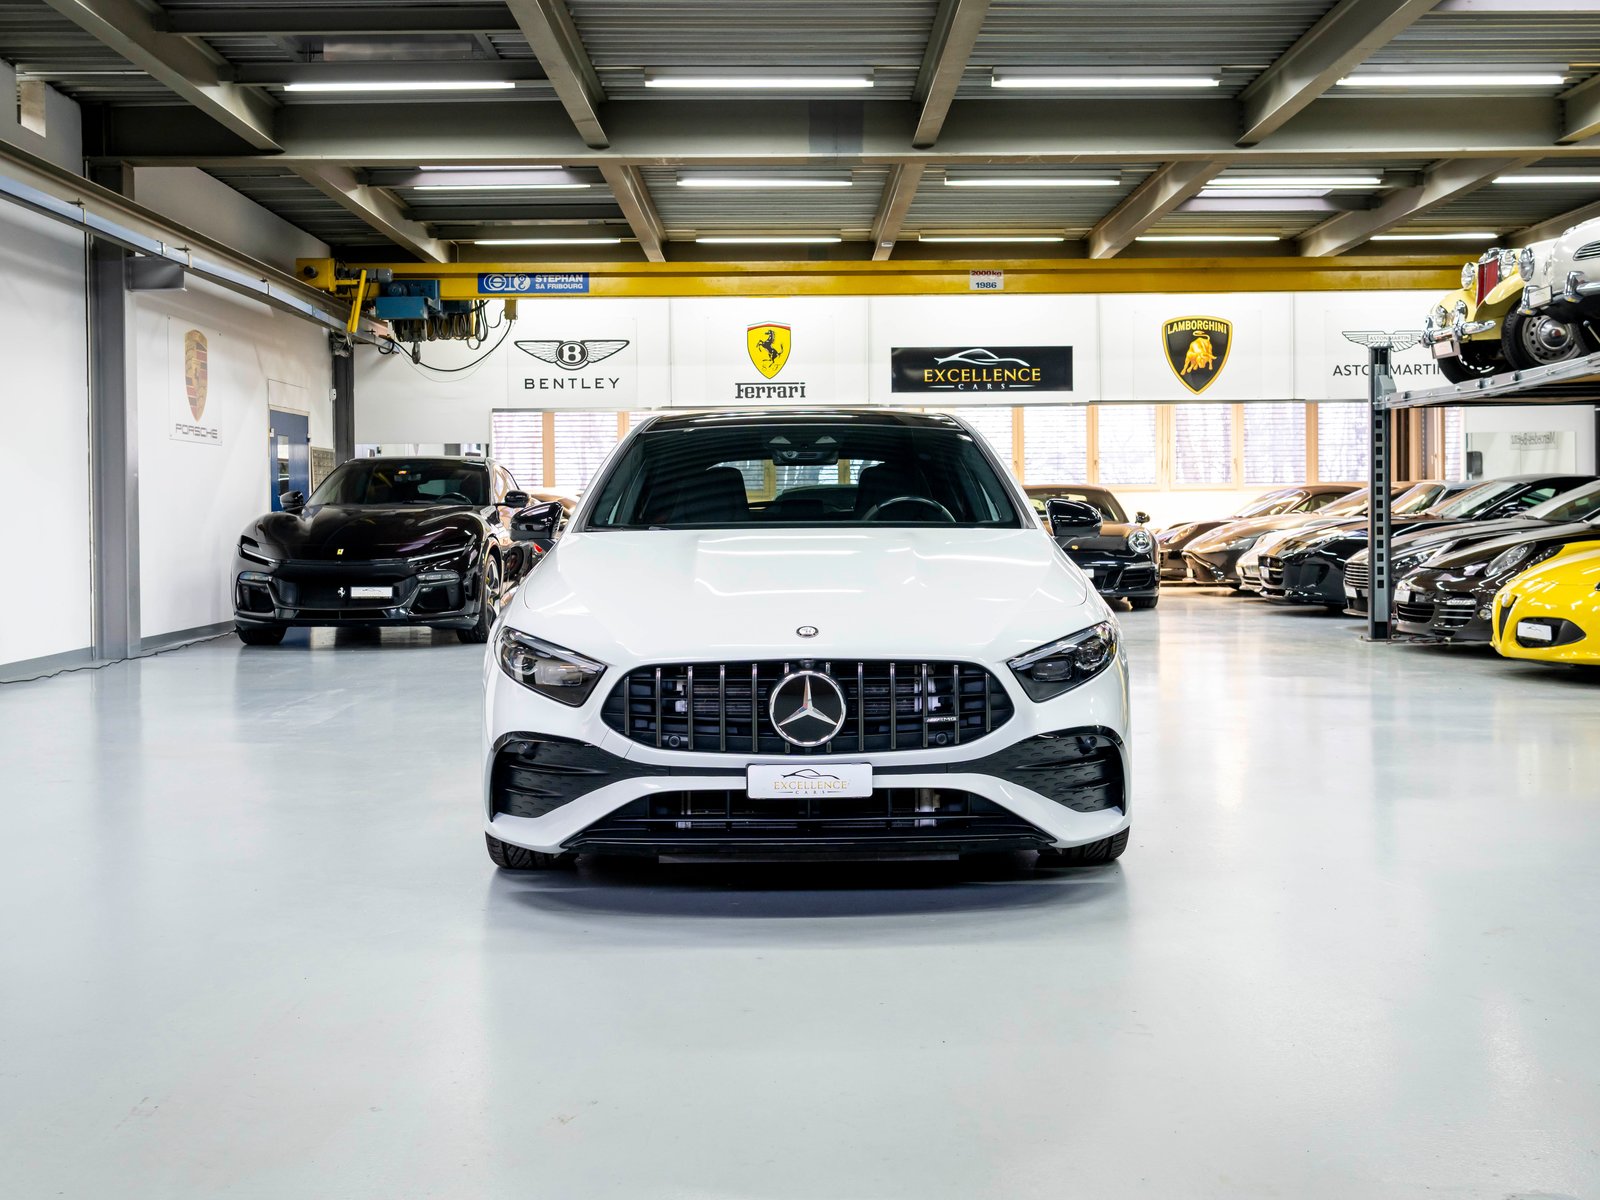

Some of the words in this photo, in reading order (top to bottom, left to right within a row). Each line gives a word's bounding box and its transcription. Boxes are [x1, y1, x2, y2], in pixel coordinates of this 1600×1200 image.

[535, 274, 584, 283] STEPHAN
[975, 281, 997, 289] 1986
[1167, 319, 1228, 335] LAMBORGHINI
[923, 367, 1041, 383] EXCELLENCE
[1332, 364, 1370, 377] ASTO
[524, 377, 620, 389] BENTLEY
[734, 382, 806, 399] Ferrari
[175, 423, 218, 439] PORSCHE
[773, 780, 848, 790] EXCELLENCE
